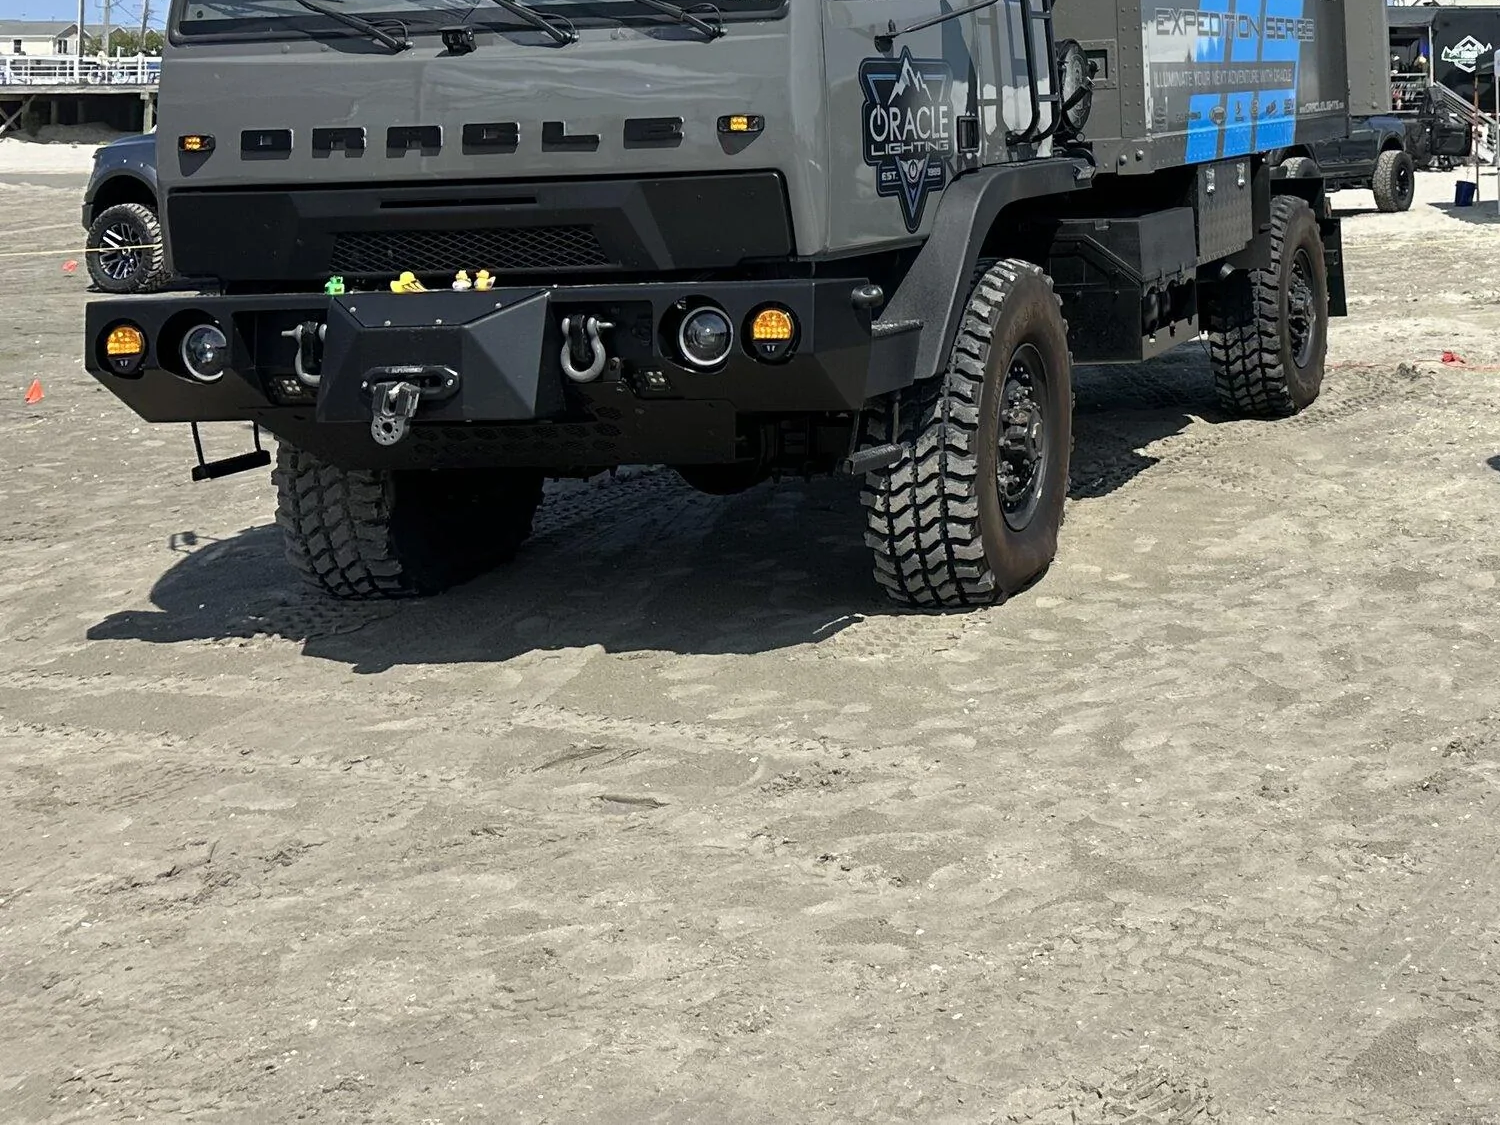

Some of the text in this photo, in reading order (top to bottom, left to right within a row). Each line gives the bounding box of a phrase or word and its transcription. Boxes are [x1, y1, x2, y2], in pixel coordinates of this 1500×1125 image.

[1155, 7, 1261, 38] EXPEDITION
[241, 117, 685, 159] ORACLE
[870, 105, 949, 142] ORACLE
[871, 140, 949, 155] LIGHTING
[882, 171, 898, 180] EST.
